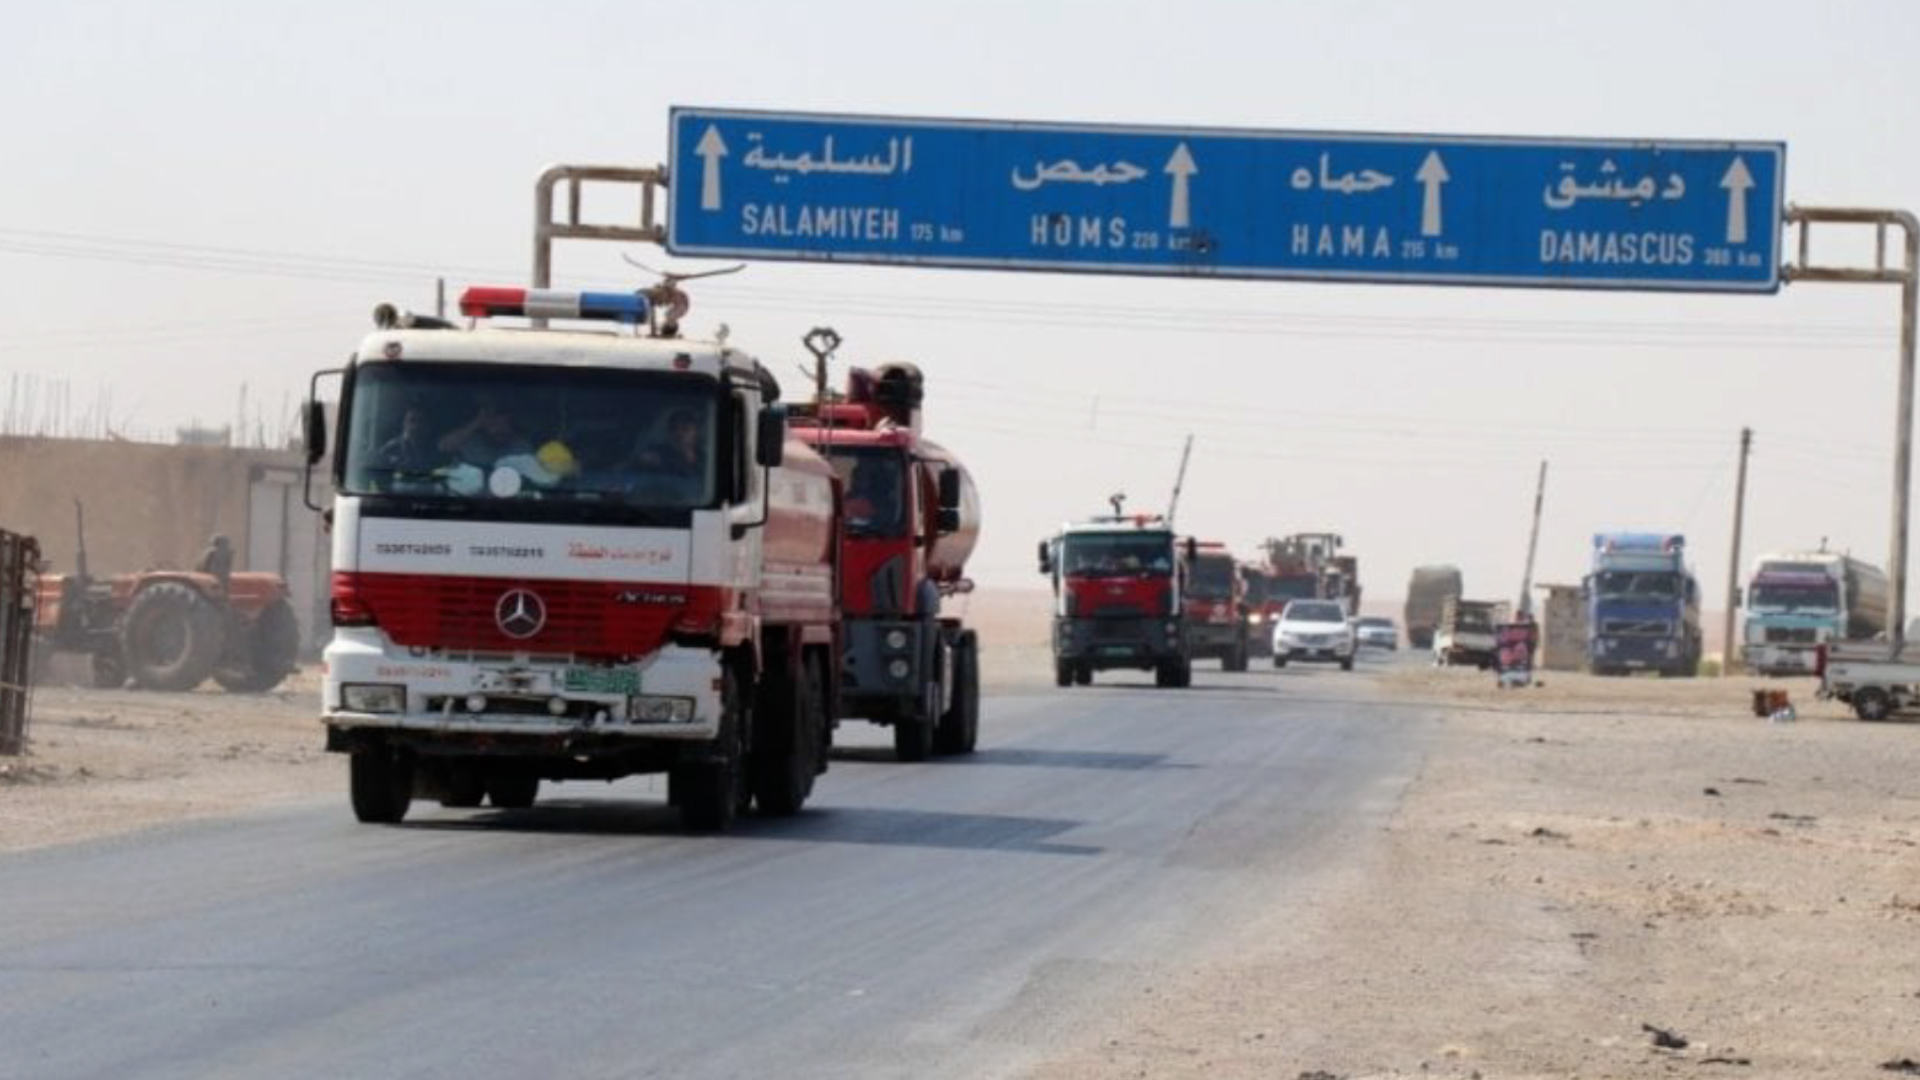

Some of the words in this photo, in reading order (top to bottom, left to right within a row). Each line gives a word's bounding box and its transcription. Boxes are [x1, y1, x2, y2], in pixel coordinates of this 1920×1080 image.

[742, 131, 913, 184] السلمية
[1011, 157, 1147, 191] حمص
[1543, 157, 1686, 209] دمشق
[742, 204, 899, 240] SALAMIYEH
[940, 223, 964, 243] km
[1031, 215, 1126, 248] HOMS
[1291, 224, 1391, 257] HAMA
[1435, 241, 1459, 259] km
[1540, 229, 1694, 265] DAMASCUS
[1738, 249, 1762, 267] km
